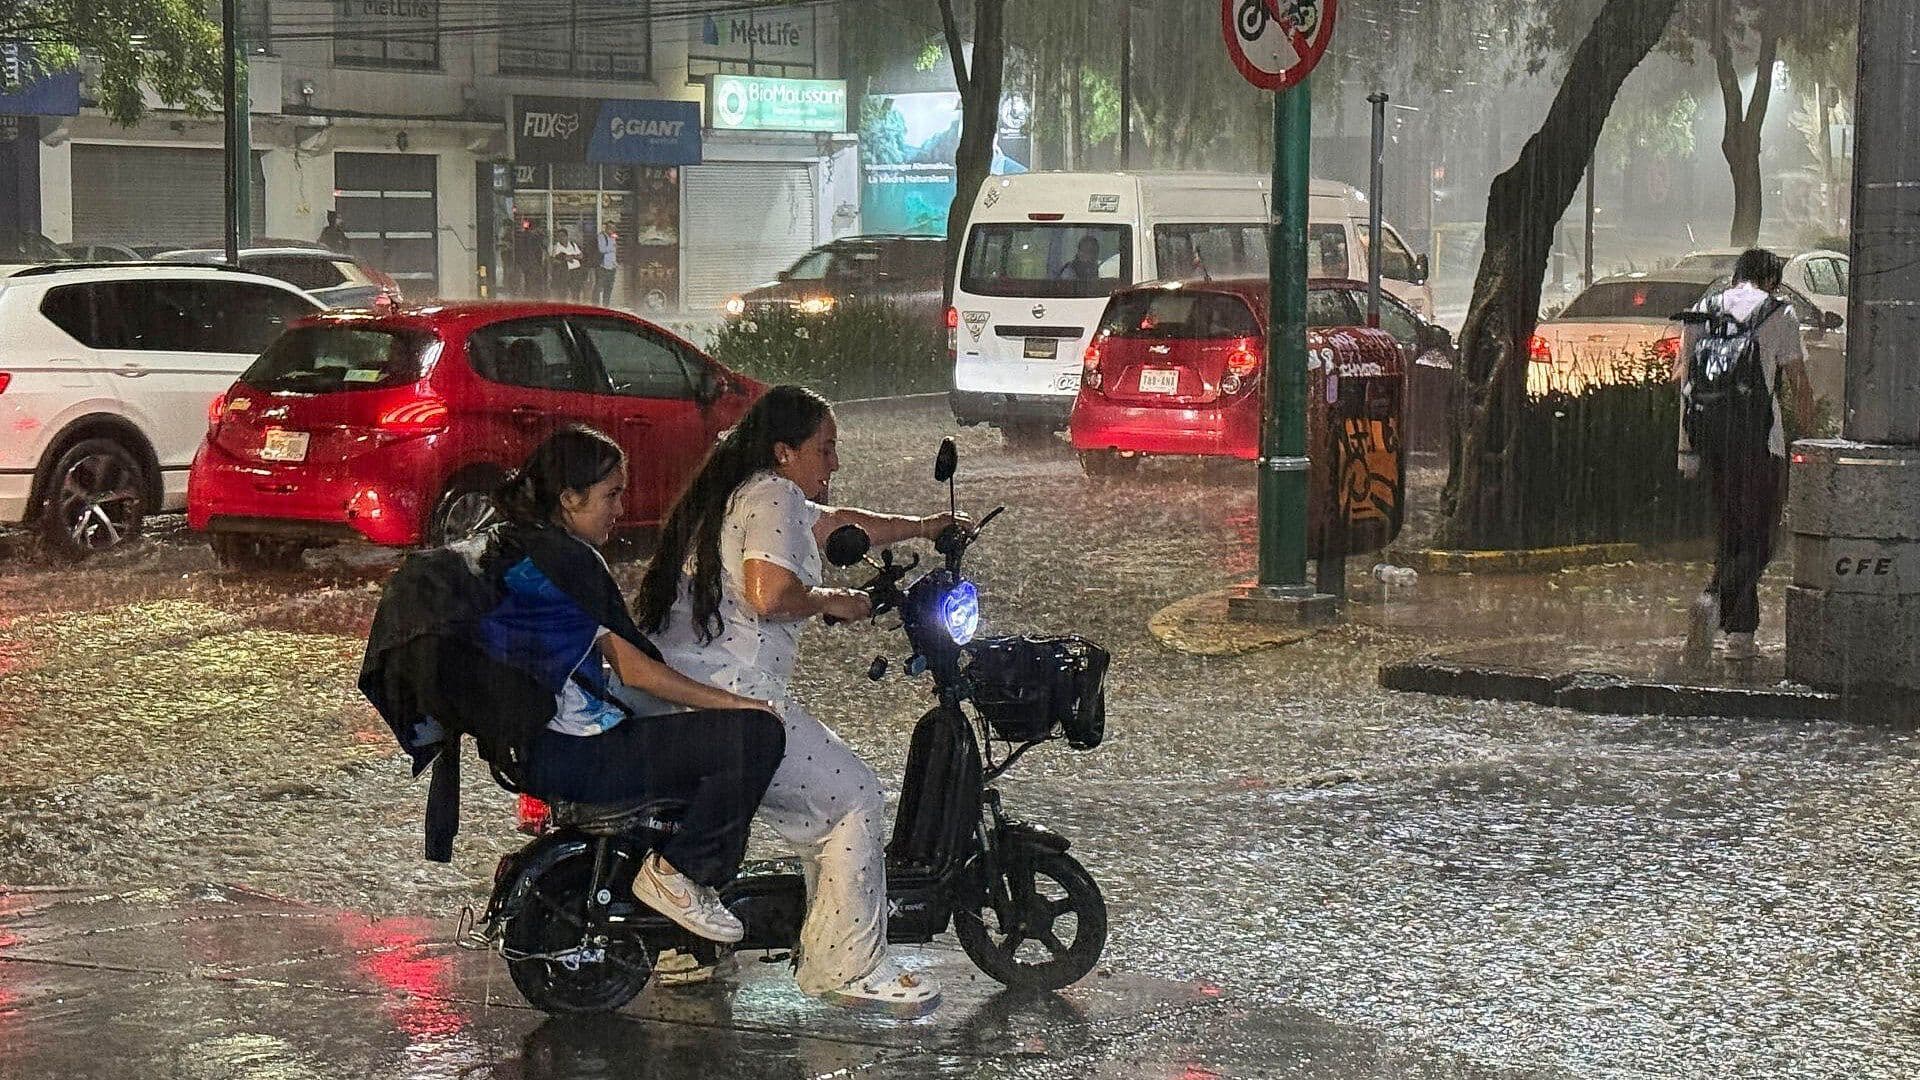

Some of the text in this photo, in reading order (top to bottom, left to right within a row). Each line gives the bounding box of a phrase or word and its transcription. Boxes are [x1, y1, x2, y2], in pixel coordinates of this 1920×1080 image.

[730, 19, 801, 46] MetLife
[523, 112, 557, 138] FOX
[625, 119, 684, 138] GIANT
[1835, 557, 1892, 576] CFE
